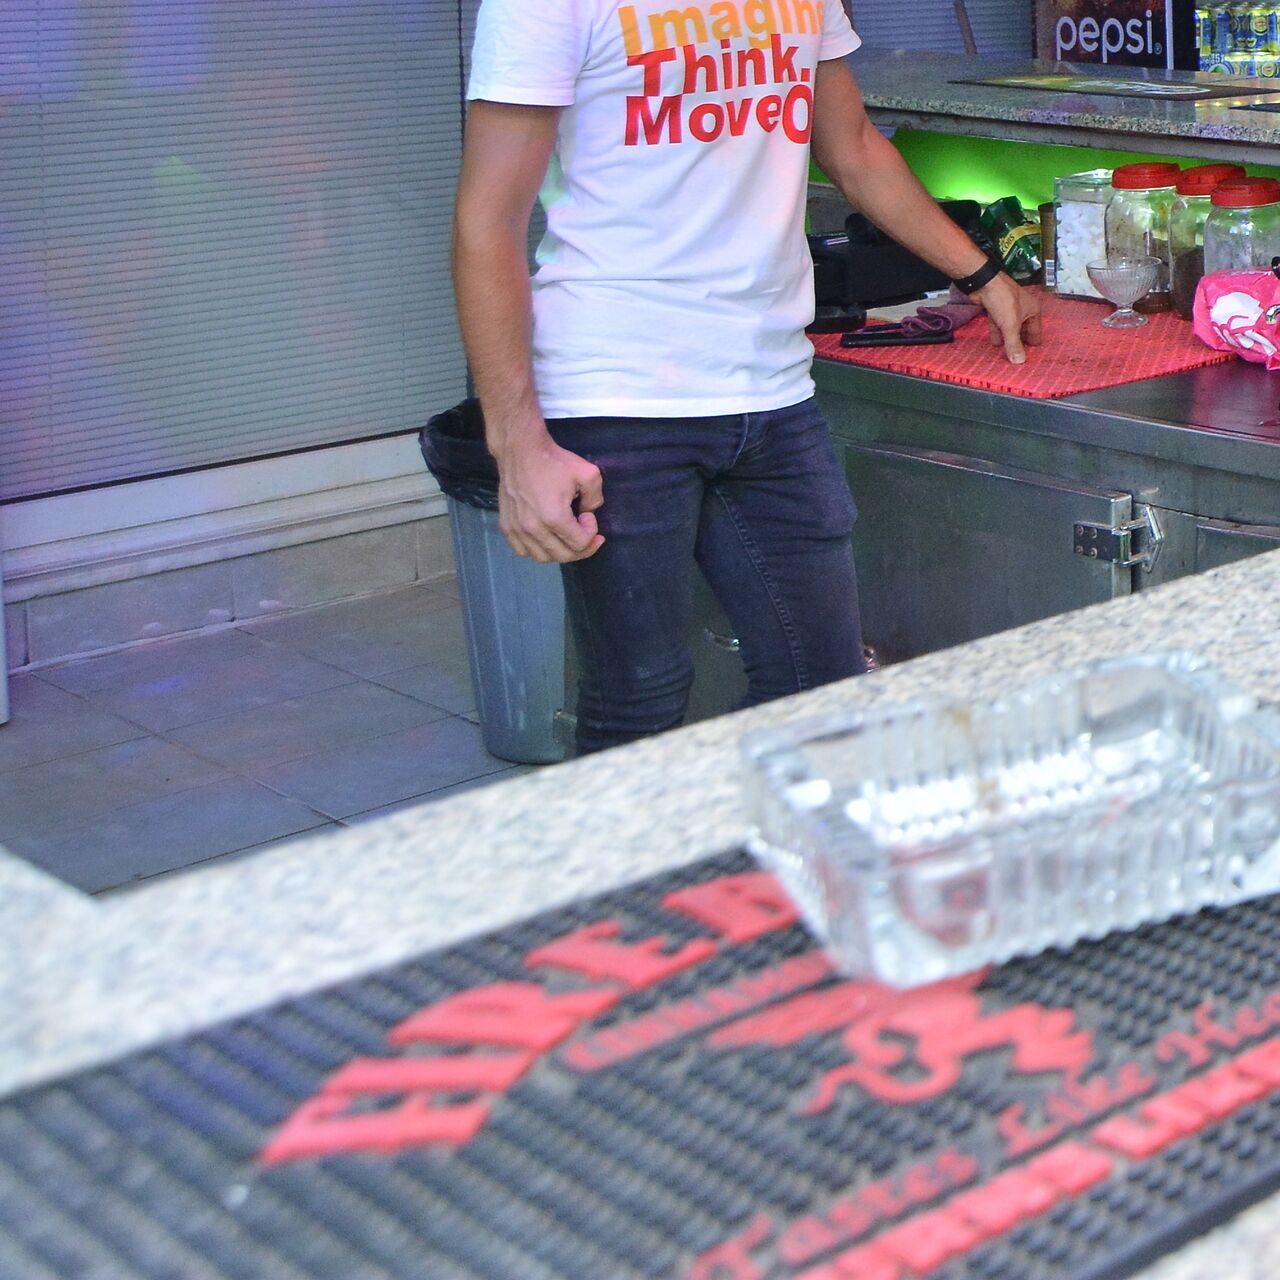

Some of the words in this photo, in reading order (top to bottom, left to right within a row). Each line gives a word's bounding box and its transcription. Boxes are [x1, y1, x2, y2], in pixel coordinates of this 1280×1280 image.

[627, 33, 811, 98] Think.
[1056, 9, 1153, 64] pepsi
[261, 871, 801, 1169] FIREB
